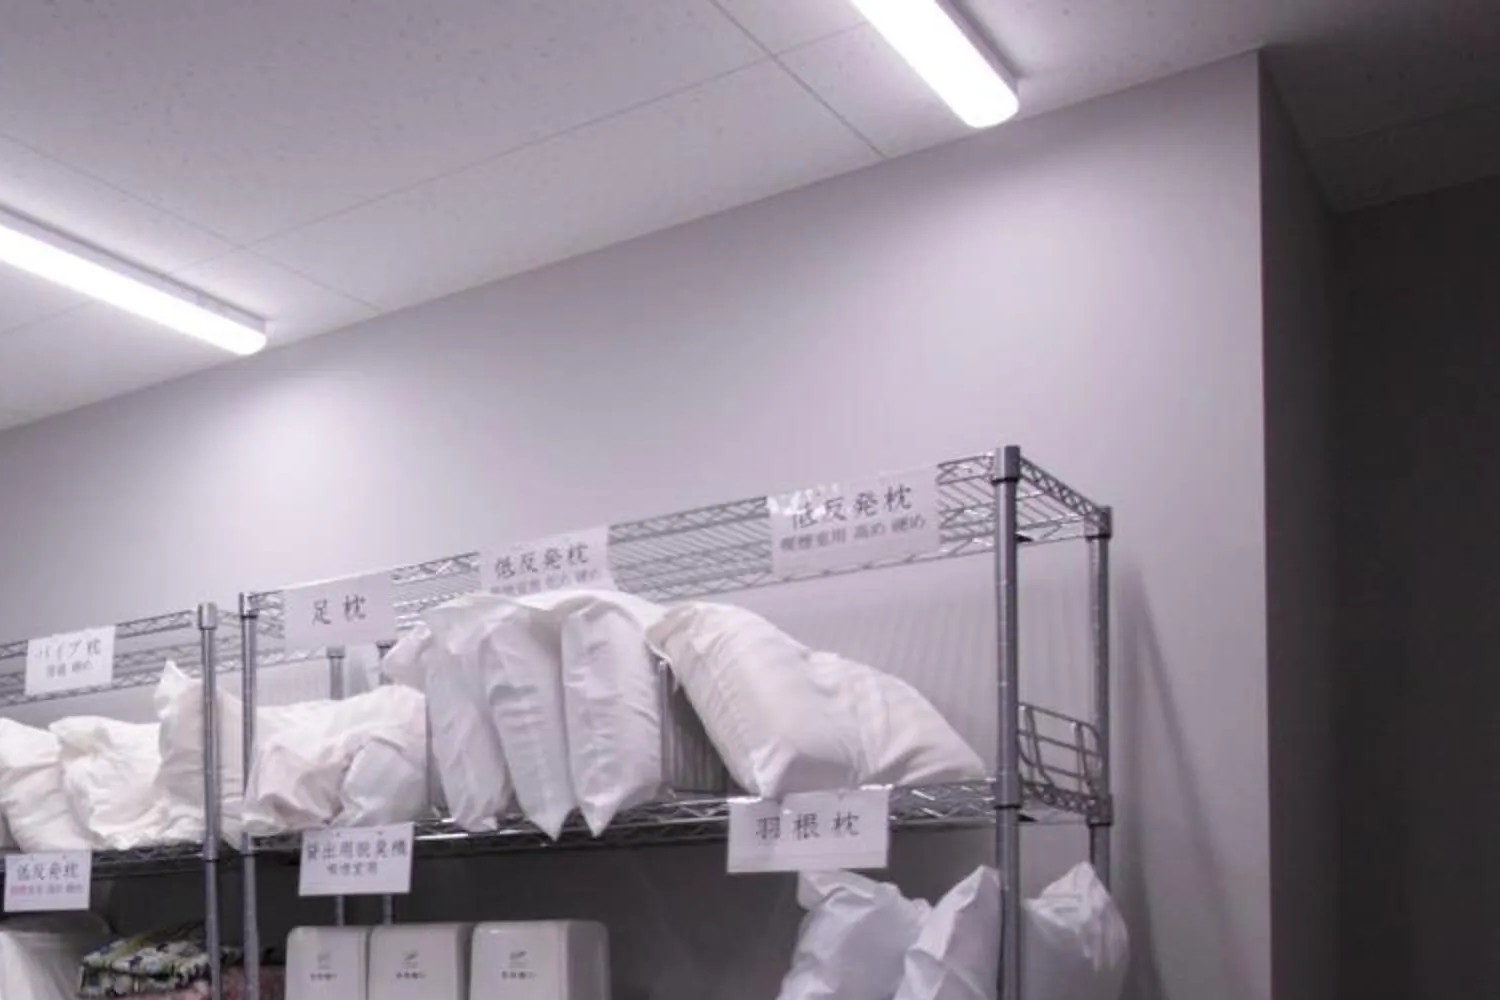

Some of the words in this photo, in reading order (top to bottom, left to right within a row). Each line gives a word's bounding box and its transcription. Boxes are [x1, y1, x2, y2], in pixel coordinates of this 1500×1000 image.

[792, 483, 912, 530] 低反発枕
[495, 542, 589, 579] 低反発枕
[311, 593, 366, 626] 足枕
[755, 810, 861, 841] 羽根枕
